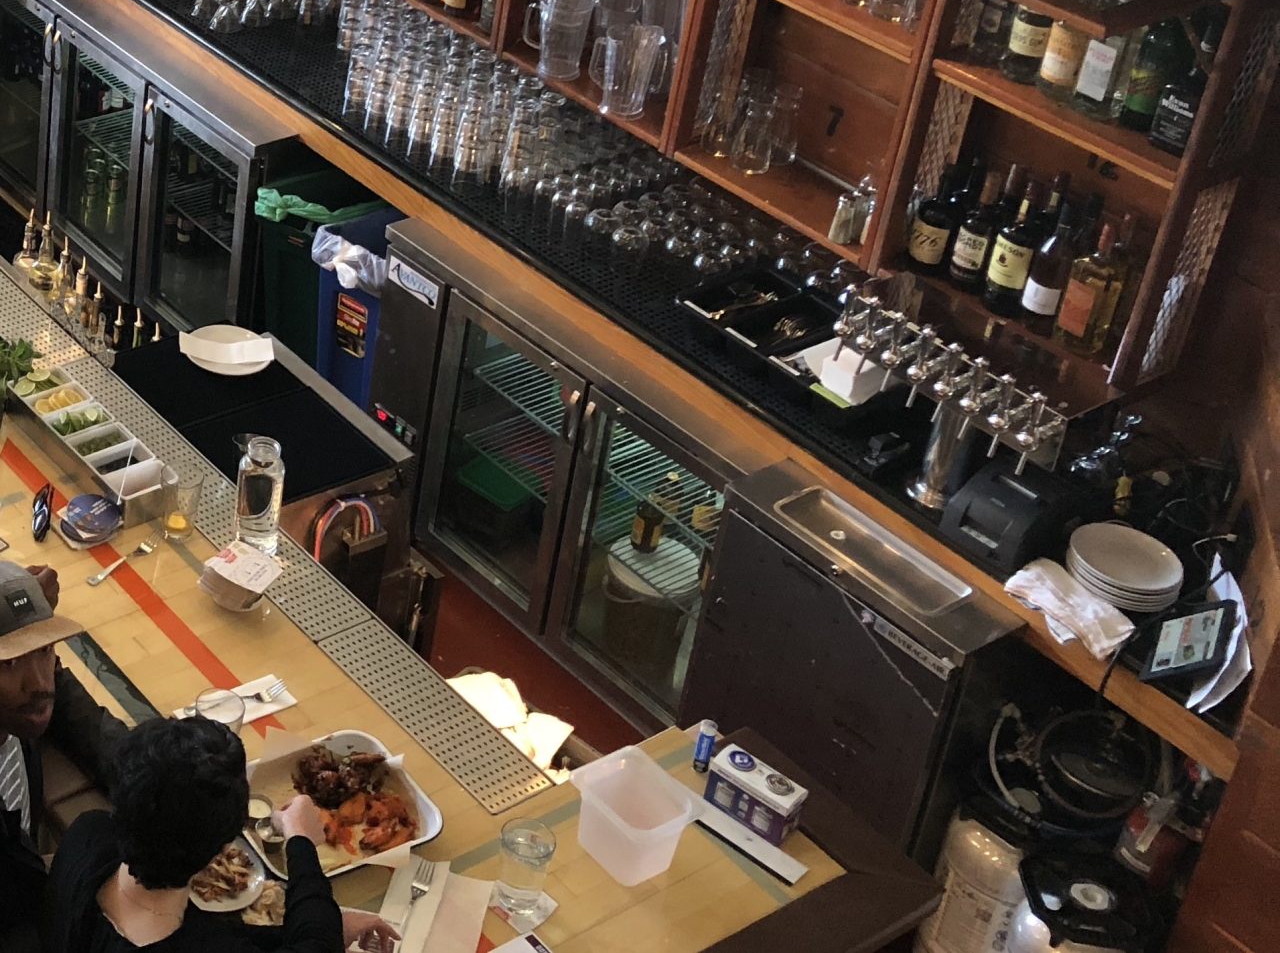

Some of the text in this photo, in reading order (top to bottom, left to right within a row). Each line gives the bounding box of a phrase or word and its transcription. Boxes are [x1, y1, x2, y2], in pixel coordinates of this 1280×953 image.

[826, 106, 845, 136] 7
[391, 263, 436, 301] AVANTCO
[13, 597, 28, 607] HUF
